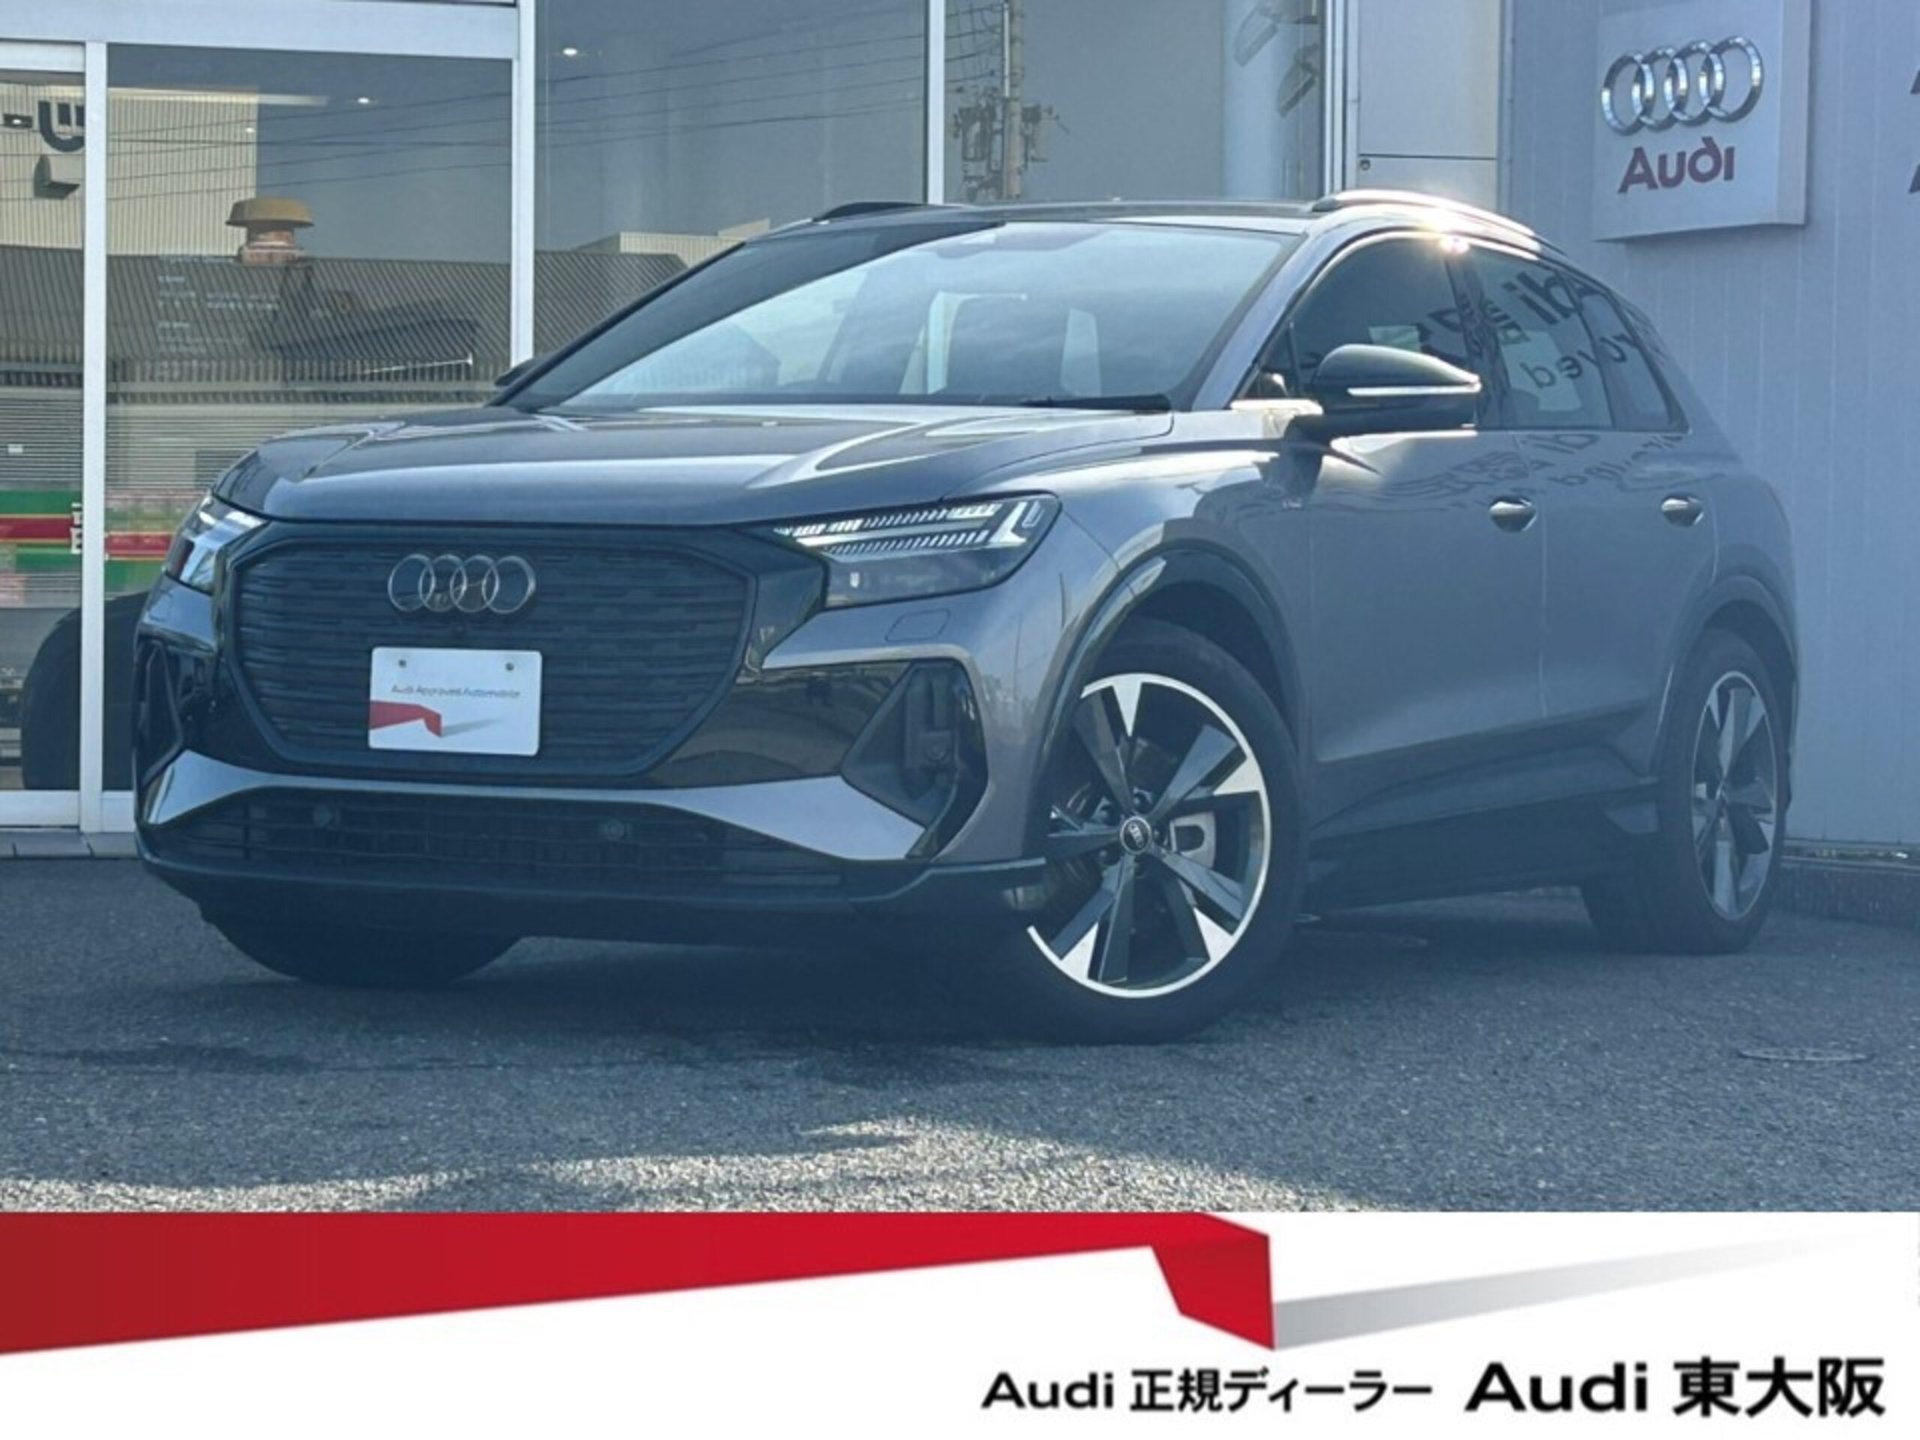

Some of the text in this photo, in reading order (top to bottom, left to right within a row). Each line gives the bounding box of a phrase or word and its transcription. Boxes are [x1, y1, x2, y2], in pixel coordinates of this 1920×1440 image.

[1617, 136, 1735, 194] Audi
[391, 684, 415, 695] Audi
[416, 684, 462, 697] Approved
